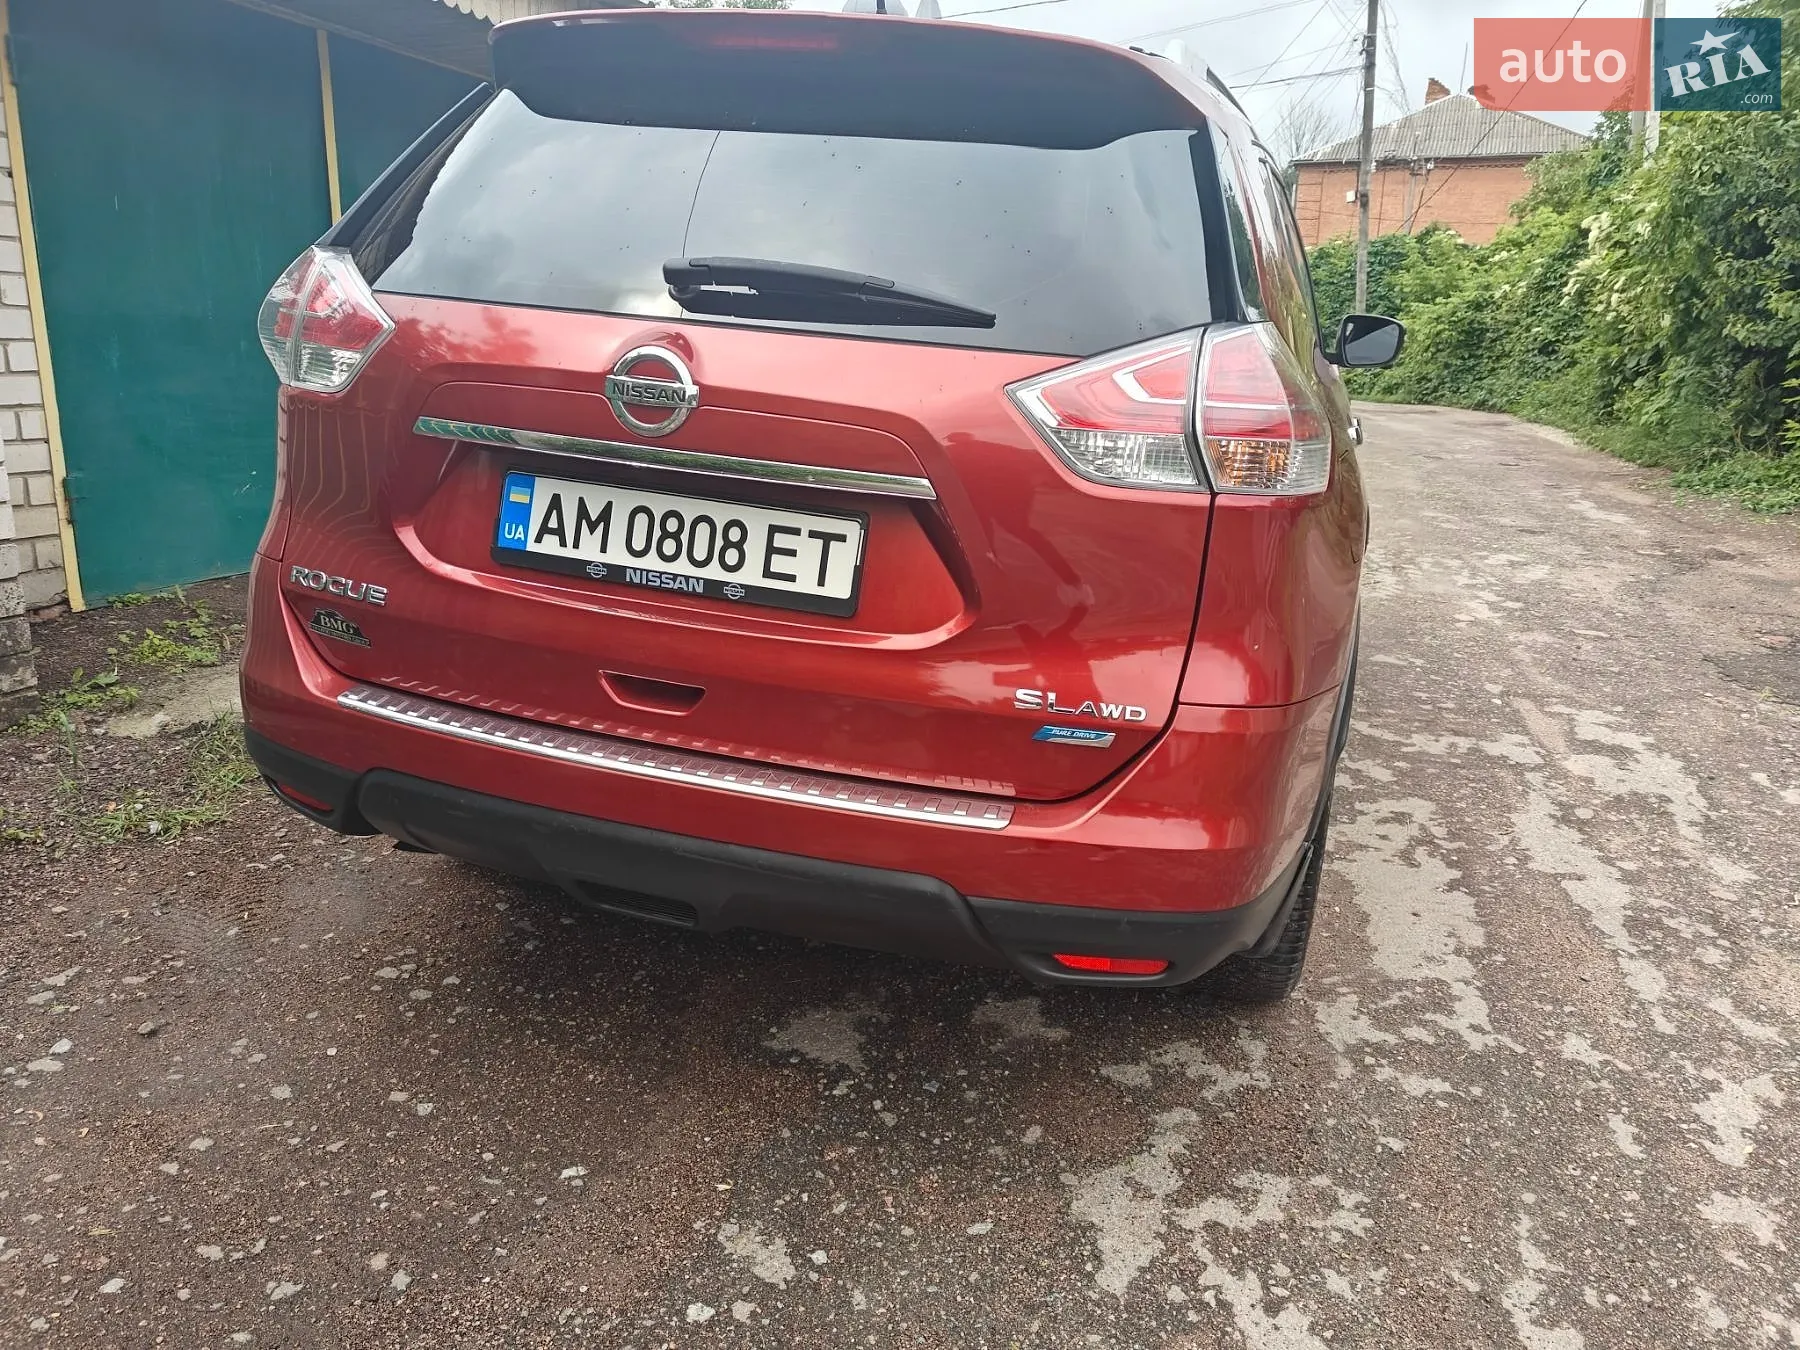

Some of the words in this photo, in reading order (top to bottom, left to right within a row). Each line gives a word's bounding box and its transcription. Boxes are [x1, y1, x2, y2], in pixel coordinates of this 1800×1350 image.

[612, 382, 687, 403] NISSAN
[504, 522, 525, 541] UA
[533, 492, 614, 554] AM
[625, 504, 748, 573] 0808
[761, 523, 847, 588] ET
[587, 566, 607, 575] NISSAN
[625, 568, 704, 593] NISSAN
[290, 565, 388, 606] ROGUE
[724, 587, 745, 597] NISSAN
[1051, 729, 1072, 737] PURE
[1073, 731, 1097, 739] DRIVE
